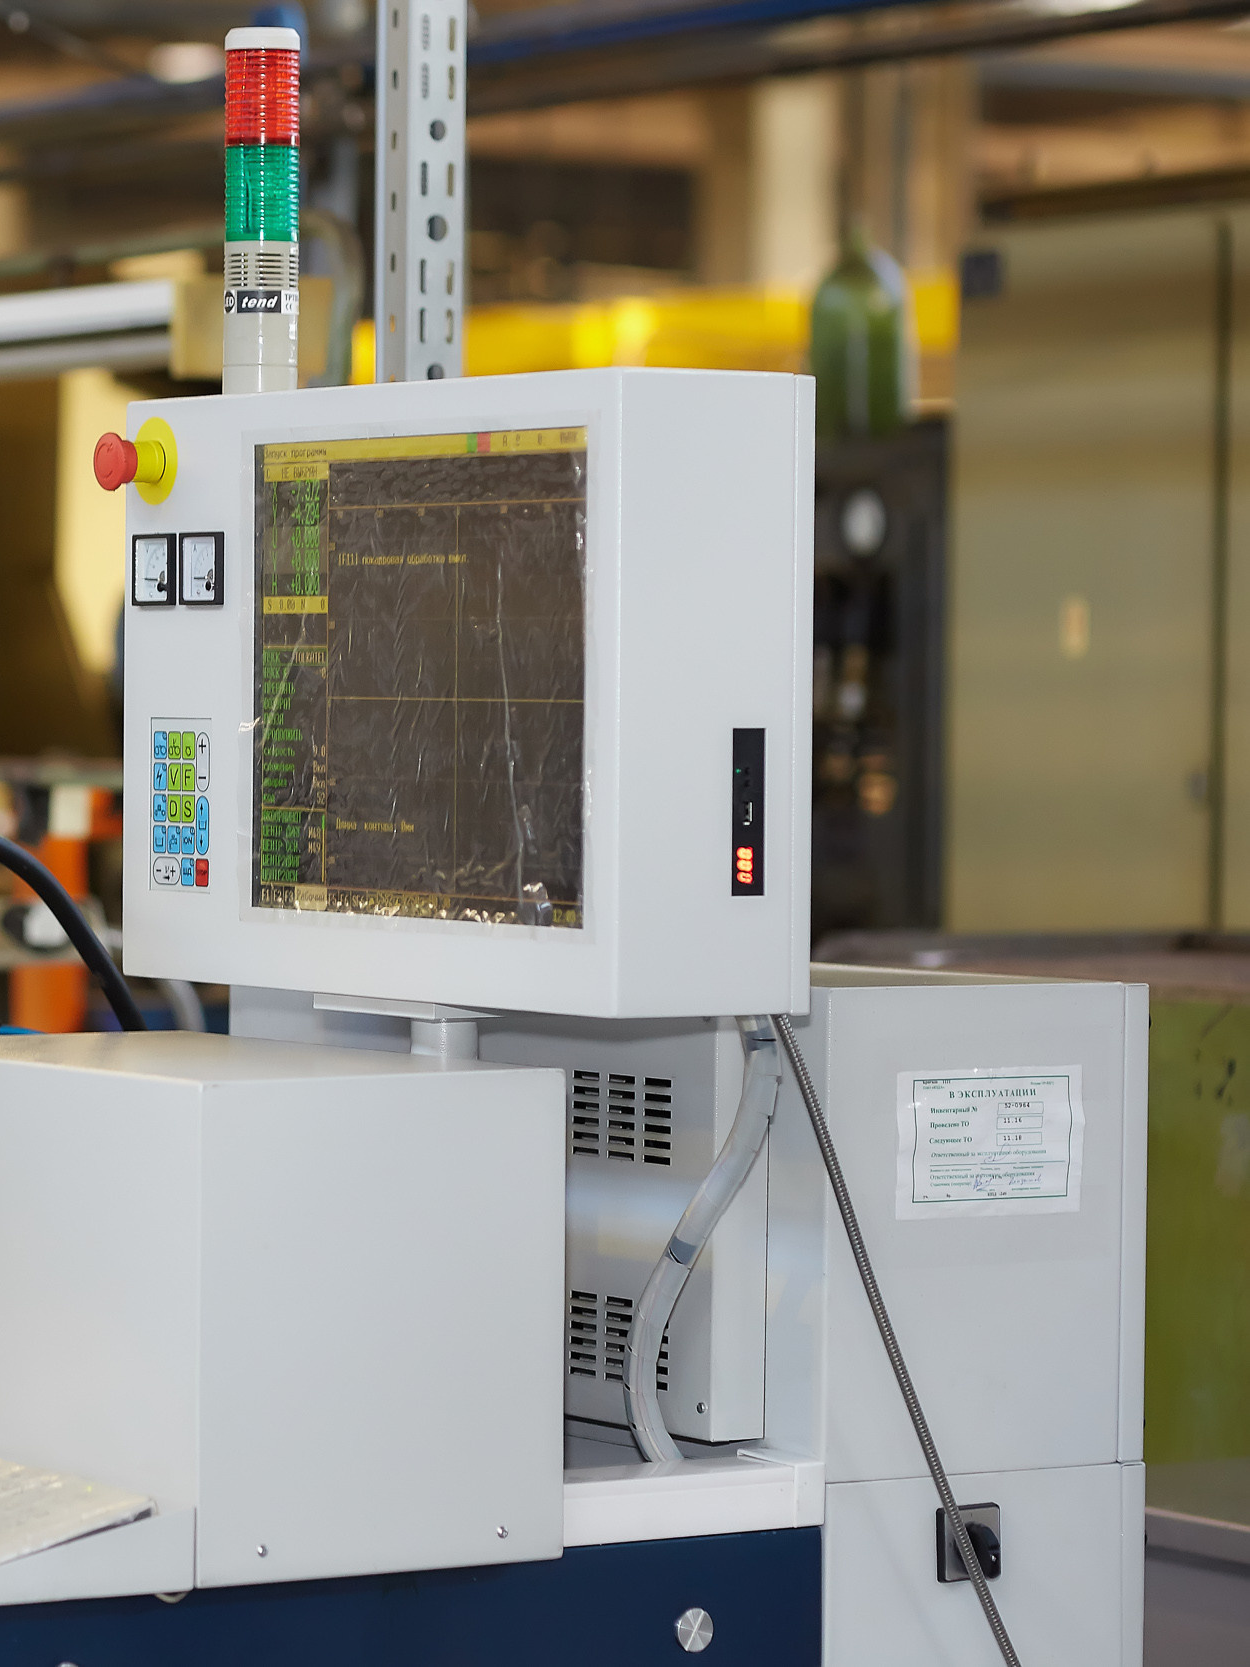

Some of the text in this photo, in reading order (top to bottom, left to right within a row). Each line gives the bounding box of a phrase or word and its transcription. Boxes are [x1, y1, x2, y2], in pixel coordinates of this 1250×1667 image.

[241, 296, 278, 308] tend
[170, 768, 179, 786] V
[184, 769, 192, 786] F
[169, 800, 178, 817] D
[183, 801, 192, 818] S
[949, 1088, 1037, 1099] В ЭКСПЛУАТАЦИИ
[930, 1106, 970, 1115] Инвентарный
